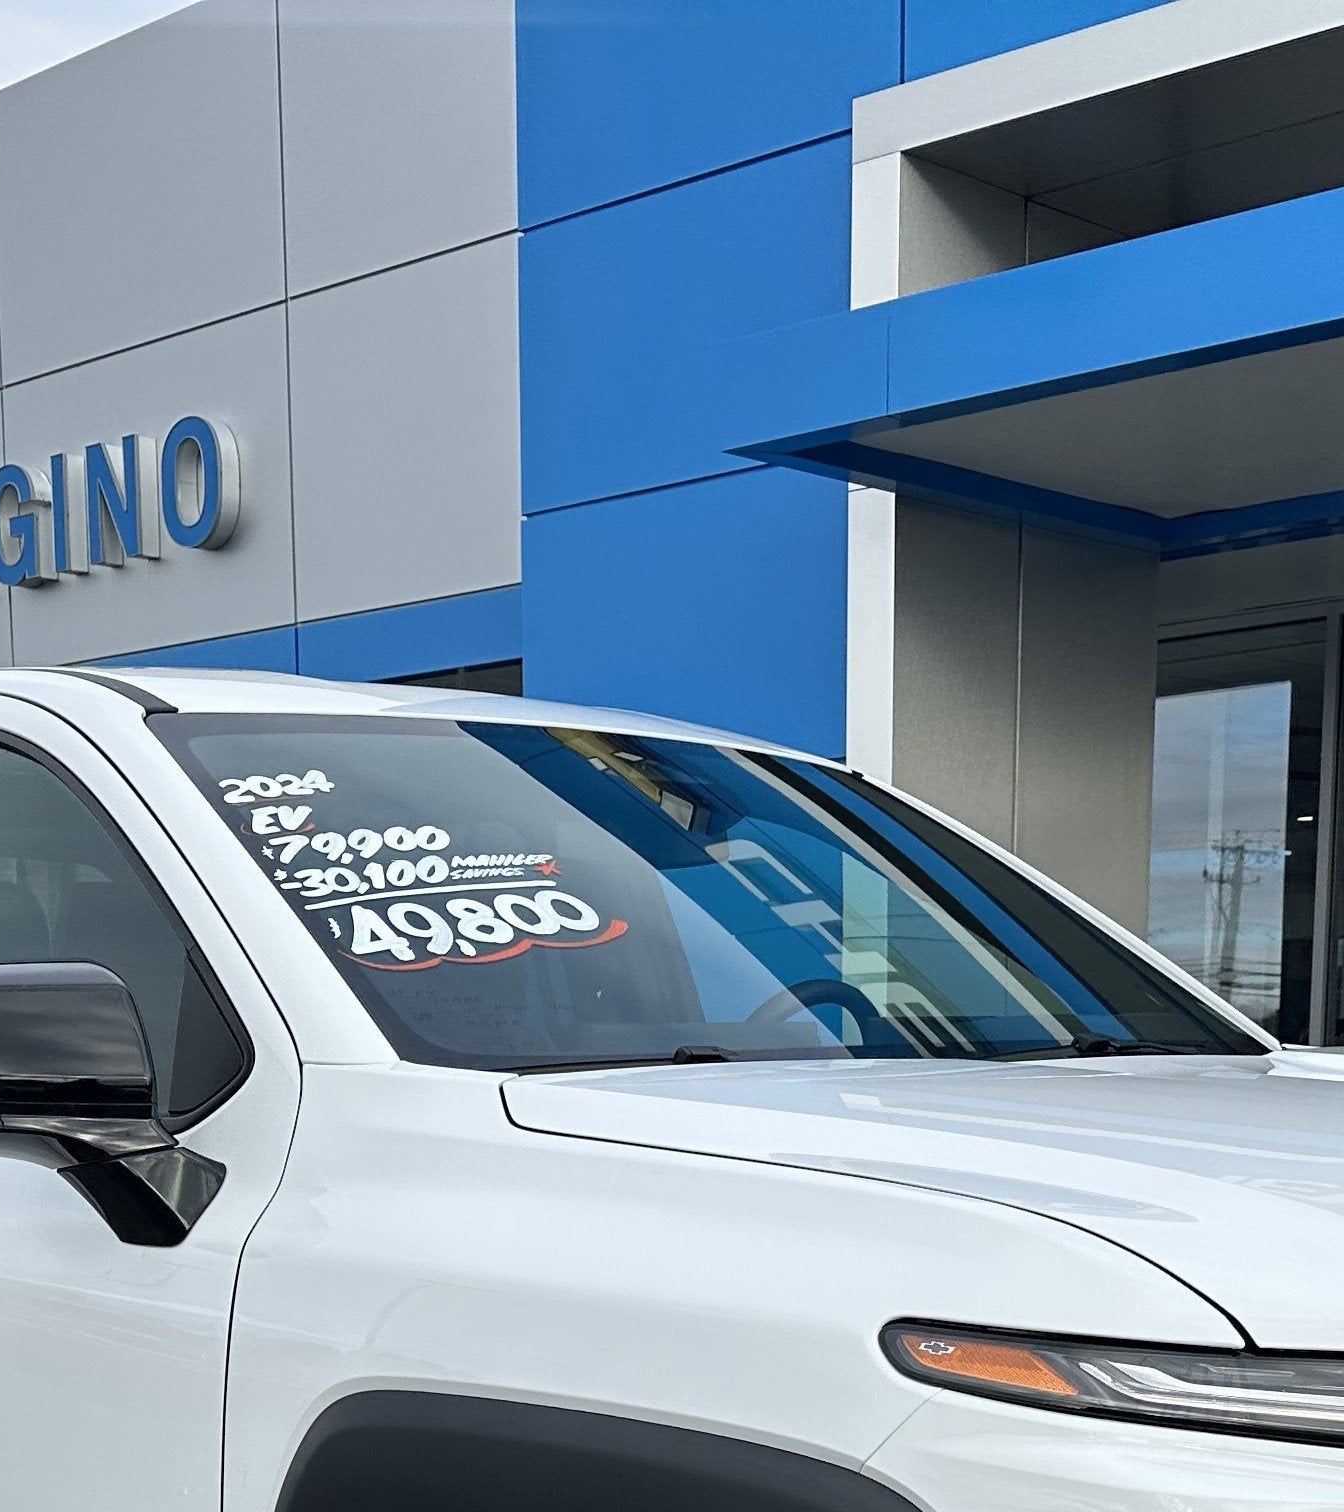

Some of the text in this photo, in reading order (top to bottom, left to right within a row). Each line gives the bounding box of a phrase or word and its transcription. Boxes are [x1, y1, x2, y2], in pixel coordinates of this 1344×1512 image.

[218, 769, 335, 803] 2024
[250, 805, 312, 835] EV
[450, 867, 525, 880] SAVINGS
